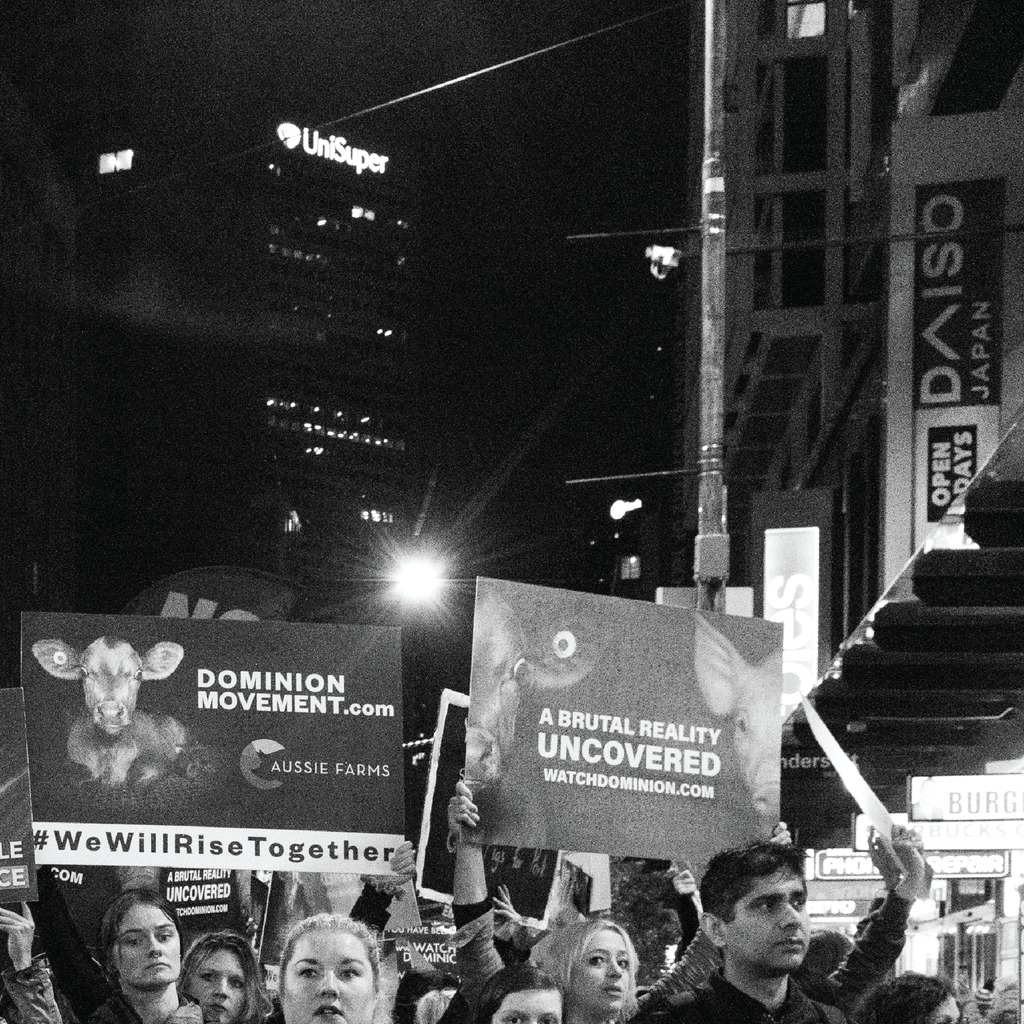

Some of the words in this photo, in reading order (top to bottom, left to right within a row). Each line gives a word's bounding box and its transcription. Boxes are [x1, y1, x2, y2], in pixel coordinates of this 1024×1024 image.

[303, 127, 389, 174] UniSuper
[971, 301, 992, 399] JAPAN
[932, 442, 952, 506] OPEN
[197, 668, 345, 694] DOMINION
[197, 691, 395, 717] MOVEMENT.com
[539, 707, 553, 725] A
[558, 709, 635, 735] BRUTAL
[639, 720, 721, 746] REALITY
[538, 732, 721, 777] UNCOVERED
[780, 753, 831, 769] nders
[271, 760, 329, 775] AUSSIE
[335, 763, 391, 777] FARMS
[543, 768, 715, 799] WATCHDOMINION.COM
[949, 791, 1024, 815] BURG
[32, 829, 395, 863] #WeWillRiseTogether
[167, 871, 174, 883] A
[174, 870, 202, 882] BRUTAL
[166, 883, 232, 903] UNCOVERED
[406, 926, 429, 934] HAVE
